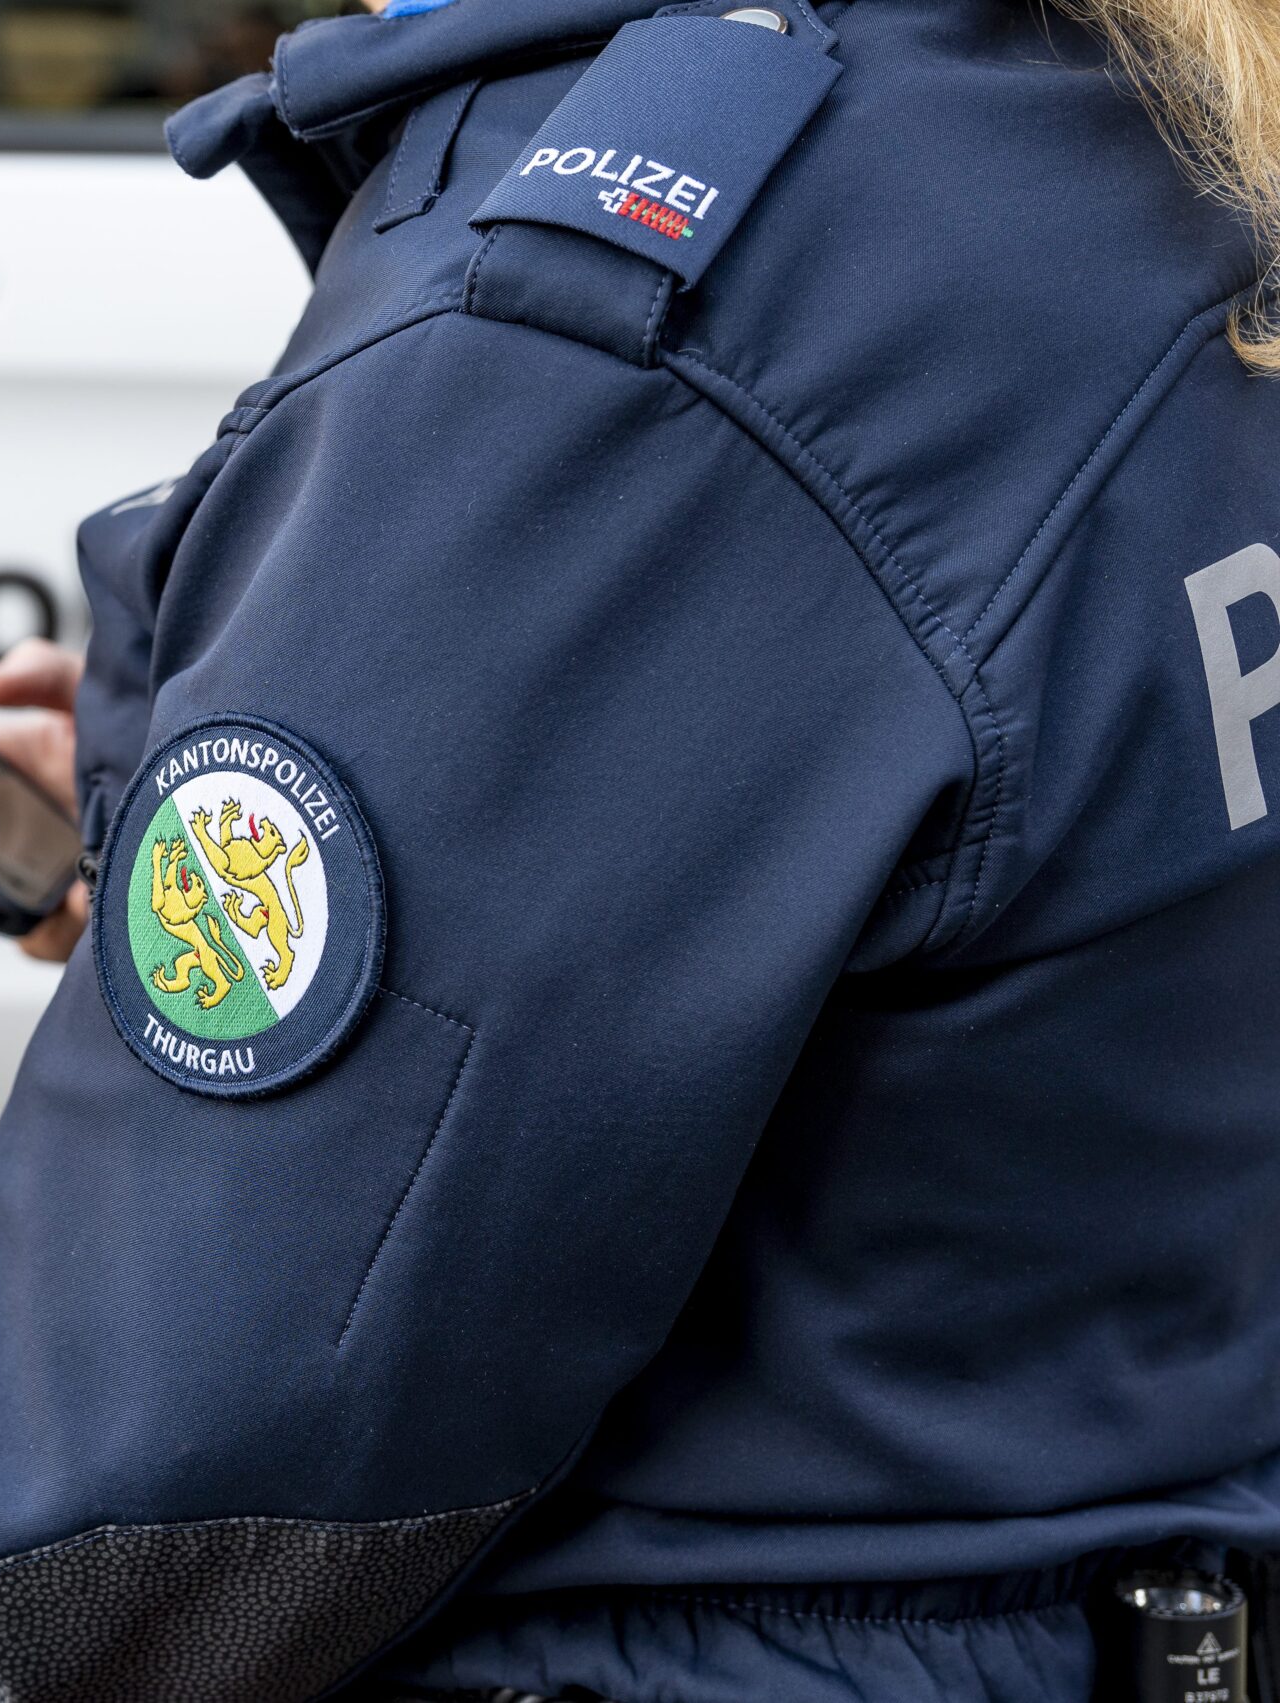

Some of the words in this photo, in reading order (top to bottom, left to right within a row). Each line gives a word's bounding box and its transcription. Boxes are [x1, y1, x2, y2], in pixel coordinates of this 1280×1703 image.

[520, 147, 719, 220] POLIZEI
[1183, 542, 1280, 831] P
[154, 738, 340, 841] KANTONSPOLIZEI
[143, 1013, 256, 1075] THURGAU
[1197, 1667, 1220, 1686] LE
